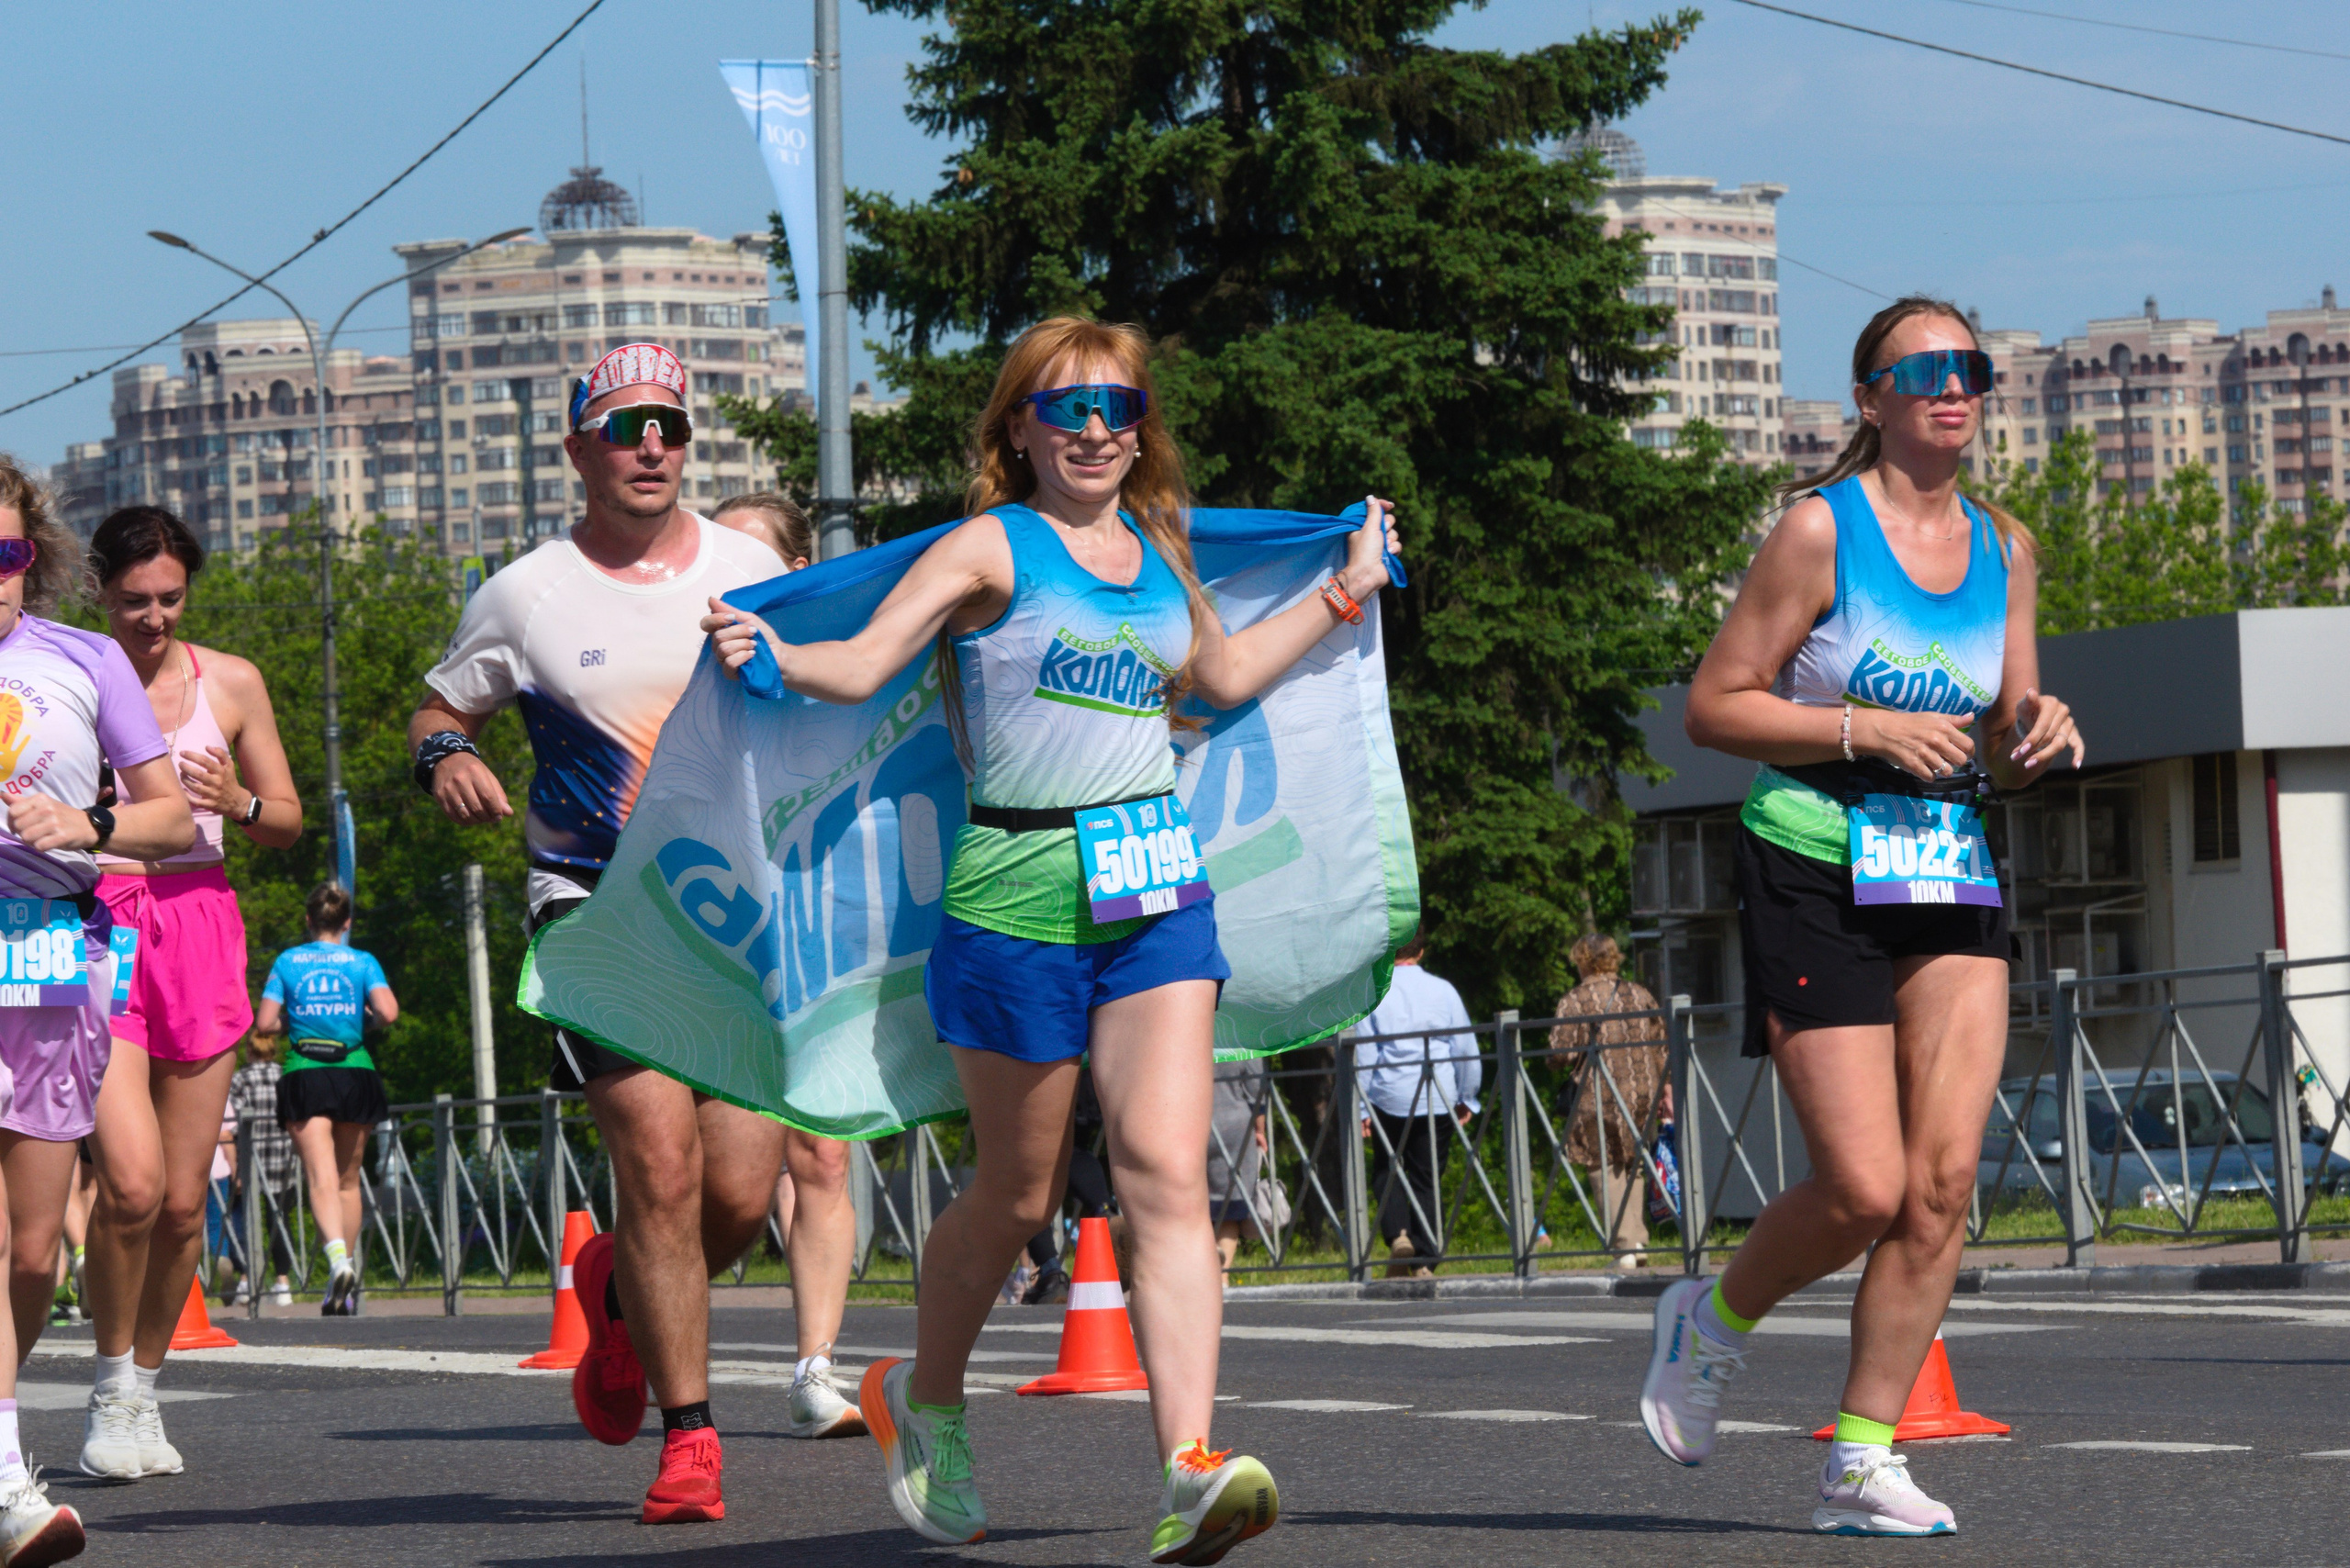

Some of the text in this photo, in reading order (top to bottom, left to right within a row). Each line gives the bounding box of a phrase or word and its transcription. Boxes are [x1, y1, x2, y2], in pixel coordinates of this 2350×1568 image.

[1060, 631, 1118, 651] БЕГОВОЕ
[1874, 643, 1993, 701] БЕГОВОЕ СООБЩЕСТВО
[6, 750, 56, 795] ДОБРА
[1865, 805, 1886, 813] ПСБ
[1093, 819, 1114, 830] ПСБ
[1093, 825, 1199, 894] 50199
[1861, 824, 1984, 880] 50227
[1138, 886, 1179, 915] 10KM
[1908, 880, 1956, 904] 10KM
[6, 902, 28, 925] 10
[0, 984, 40, 1006] 0KM
[295, 1002, 356, 1016] САТУРН
